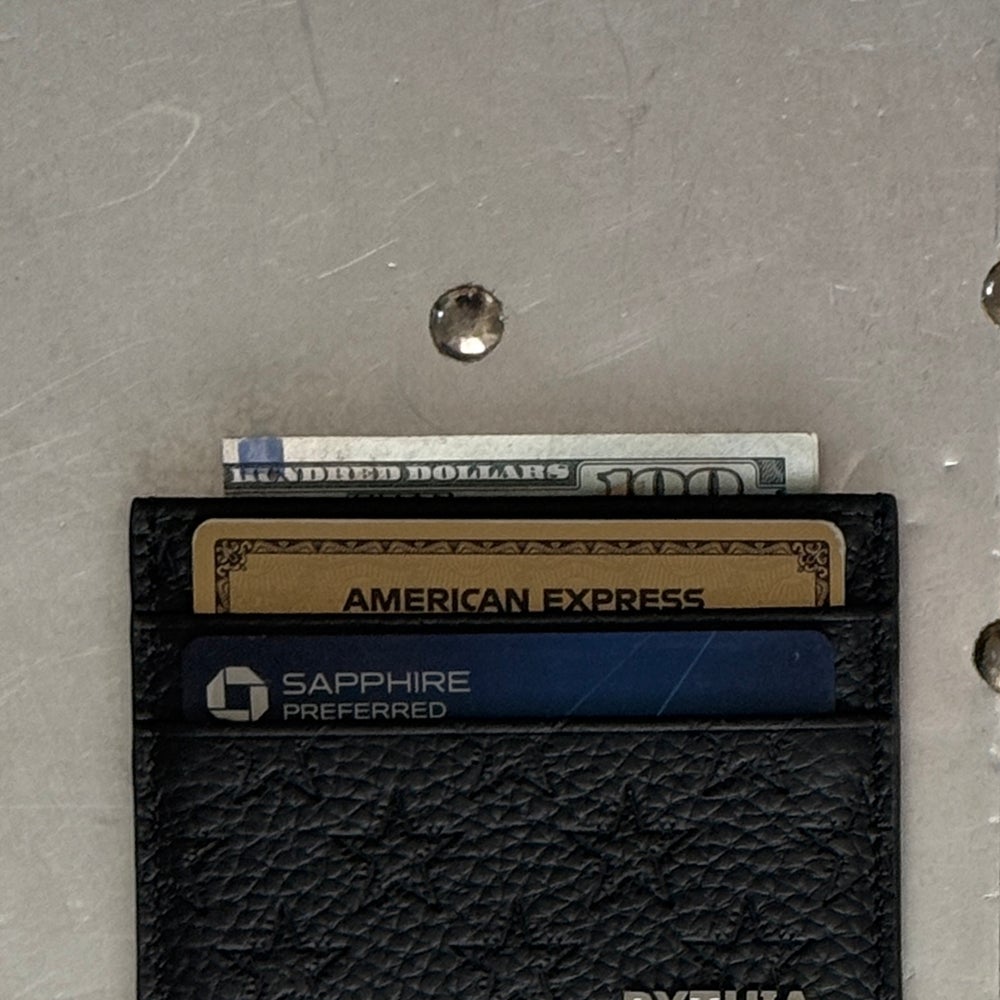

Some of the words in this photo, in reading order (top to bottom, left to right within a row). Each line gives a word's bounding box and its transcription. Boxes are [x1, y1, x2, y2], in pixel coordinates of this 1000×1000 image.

[406, 464, 570, 481] DOLLARS
[596, 467, 744, 496] 100
[343, 588, 529, 613] AMERICAN
[543, 588, 705, 612] EXPRESS
[282, 671, 471, 695] SAPPHIRE
[283, 702, 447, 720] PREFERRED
